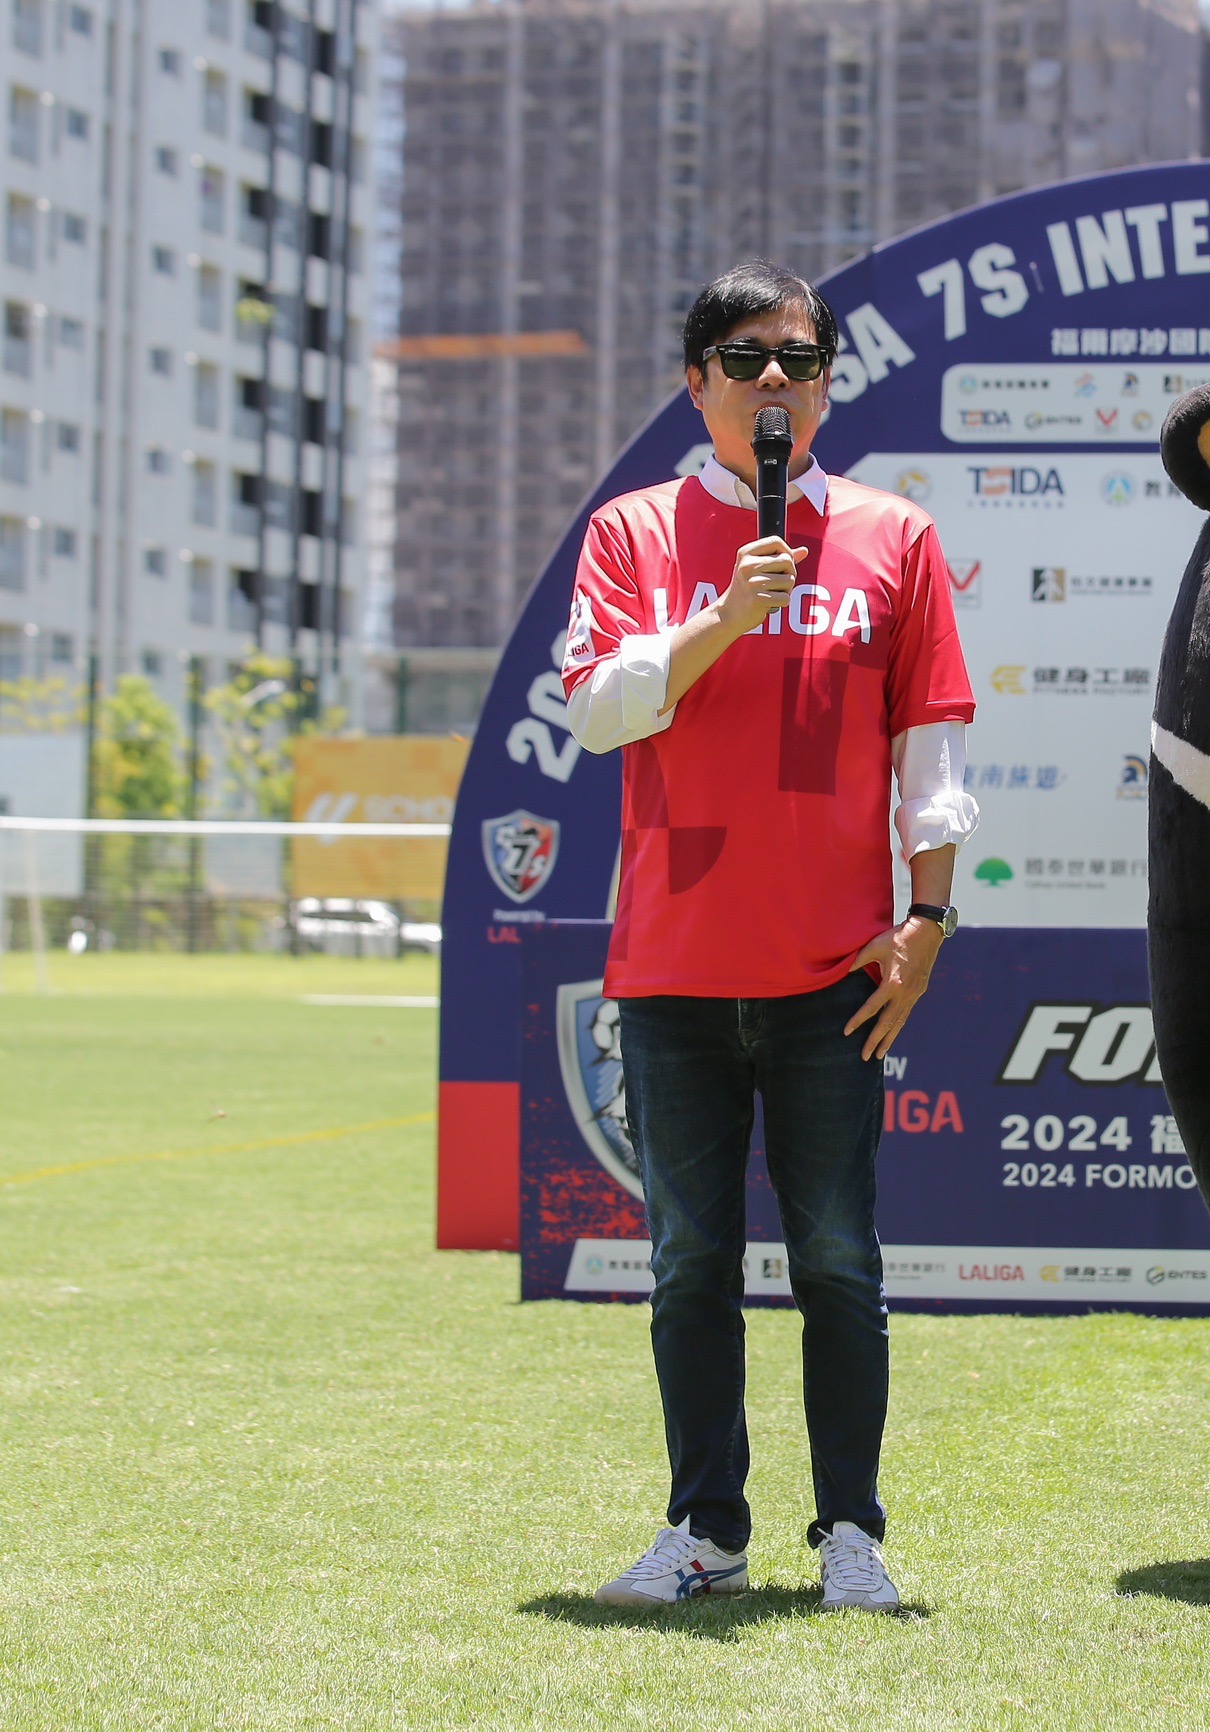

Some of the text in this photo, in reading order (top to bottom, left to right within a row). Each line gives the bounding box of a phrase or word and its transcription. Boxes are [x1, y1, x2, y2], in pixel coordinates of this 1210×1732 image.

[917, 243, 1029, 341] 7S
[1002, 1006, 1163, 1081] FO
[1000, 1114, 1132, 1151] 2024
[1003, 1163, 1076, 1187] 2024
[958, 1264, 1025, 1281] LALIGA
